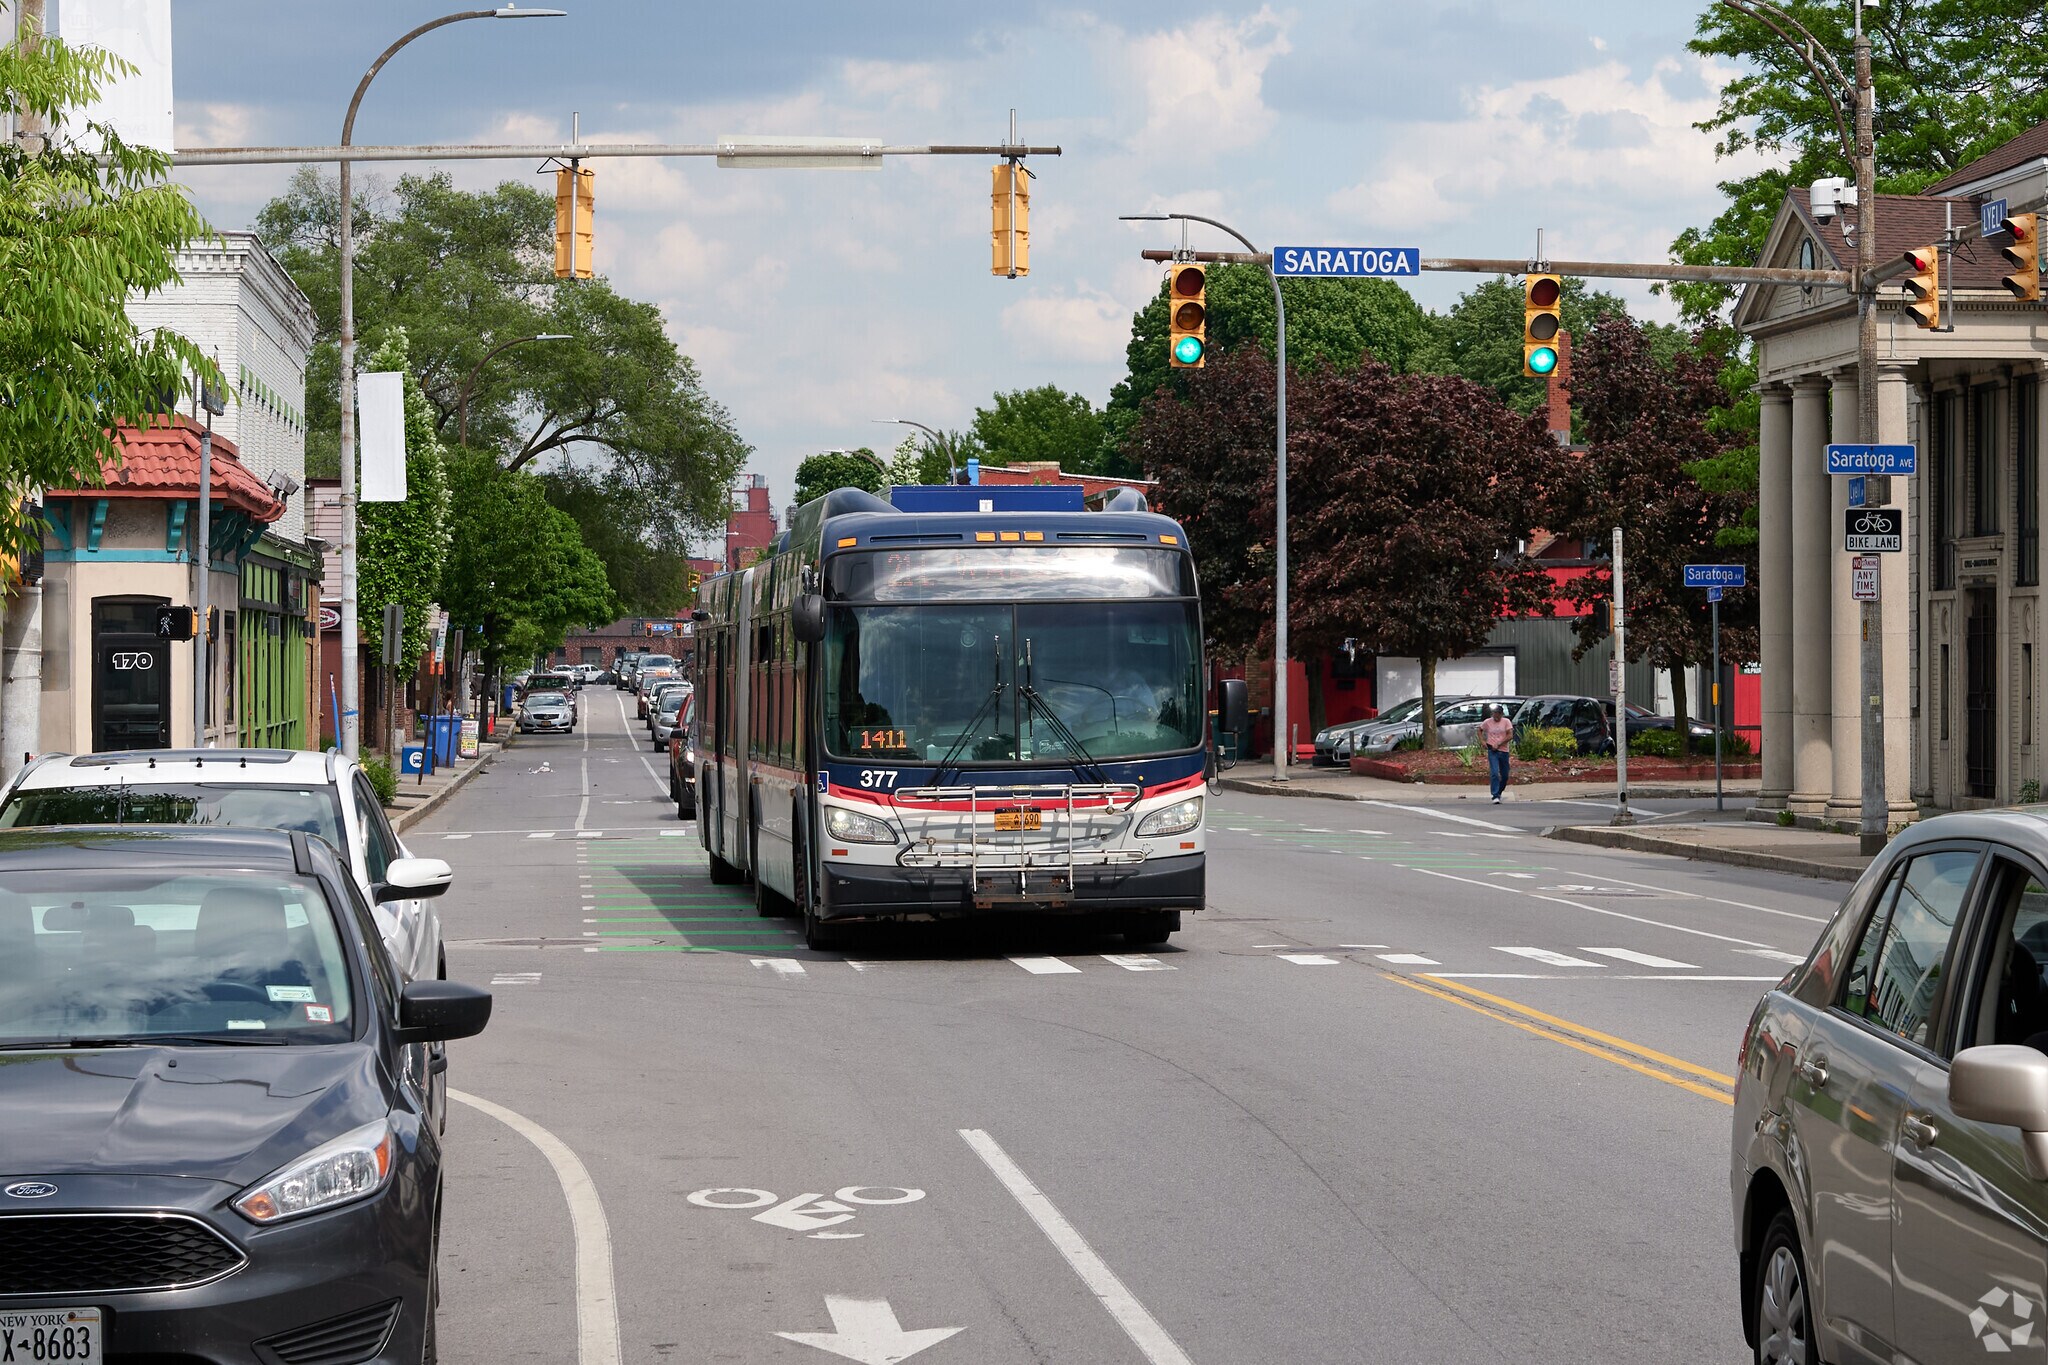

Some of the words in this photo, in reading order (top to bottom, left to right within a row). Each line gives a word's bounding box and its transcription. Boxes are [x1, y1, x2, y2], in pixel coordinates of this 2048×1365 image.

[1983, 203, 2003, 232] LYELL
[1284, 249, 1411, 273] SARATOGA
[1831, 450, 1895, 472] Saratoga
[1899, 458, 1913, 468] AVE
[1849, 536, 1869, 548] BIKE
[1875, 536, 1898, 549] LANE
[1853, 558, 1862, 568] NO
[1688, 567, 1733, 583] Saratoga
[1857, 571, 1873, 580] ANY
[1856, 580, 1875, 590] TIME
[112, 652, 153, 670] 170
[861, 730, 907, 749] 1411
[860, 769, 898, 788] 377
[16, 1185, 46, 1195] Ford
[30, 1313, 66, 1326] YORK
